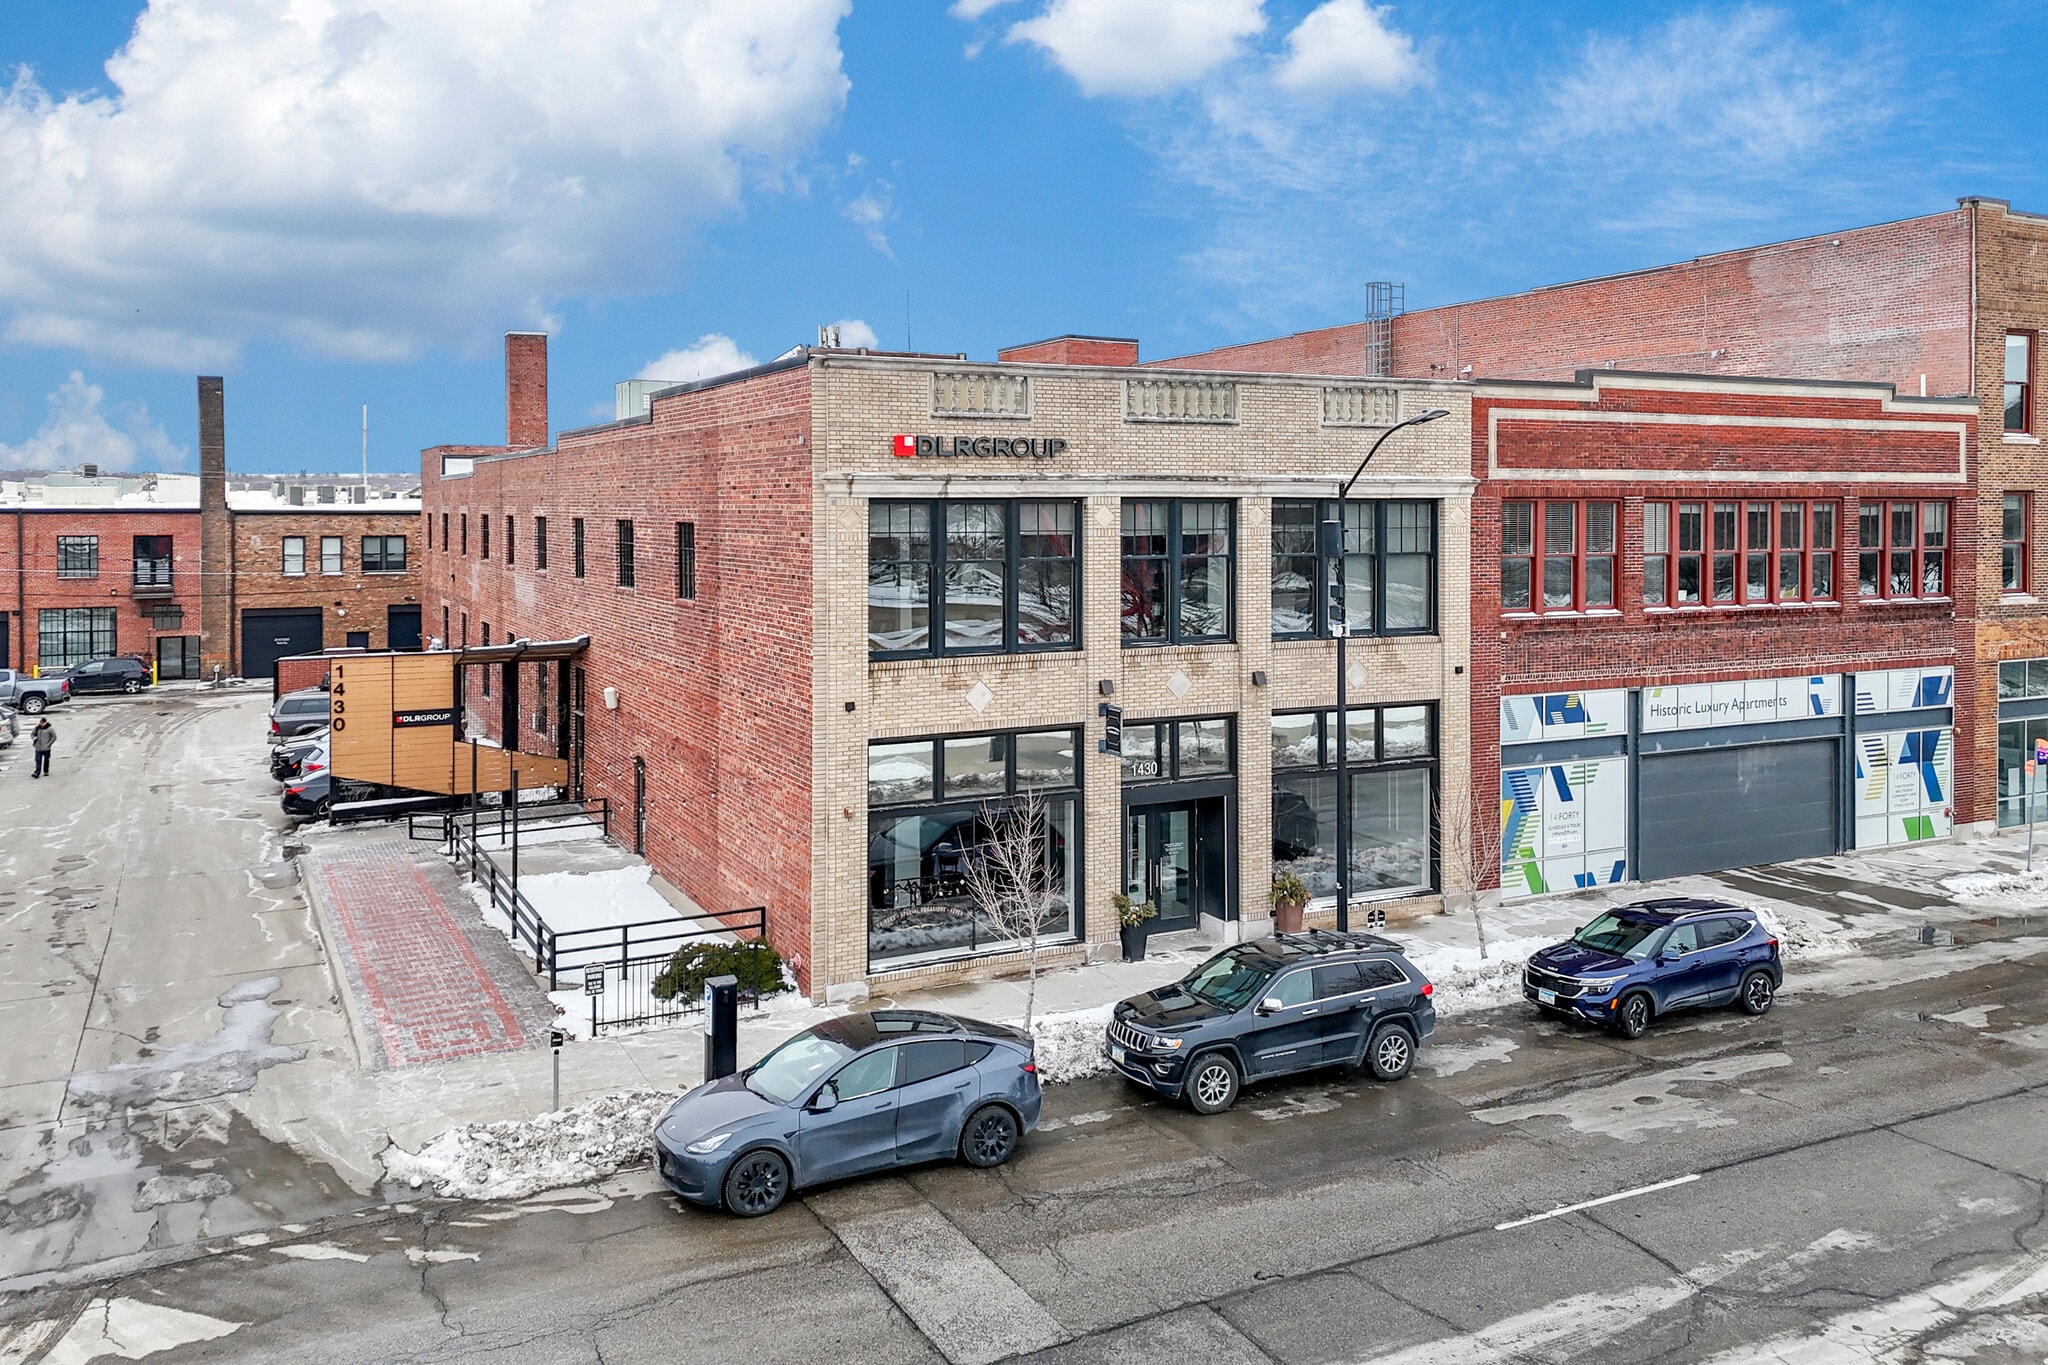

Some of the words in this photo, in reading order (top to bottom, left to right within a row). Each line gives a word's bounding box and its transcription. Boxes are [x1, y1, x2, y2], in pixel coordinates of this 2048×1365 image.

[916, 435, 1068, 458] DLRGROUP
[333, 665, 346, 731] 1430
[1650, 702, 1692, 717] Historic
[1695, 701, 1730, 715] Luxury
[1731, 697, 1788, 714] Apartments
[402, 713, 451, 723] DLRGROUP
[1131, 761, 1158, 777] 1430
[1559, 810, 1580, 821] FORTY
